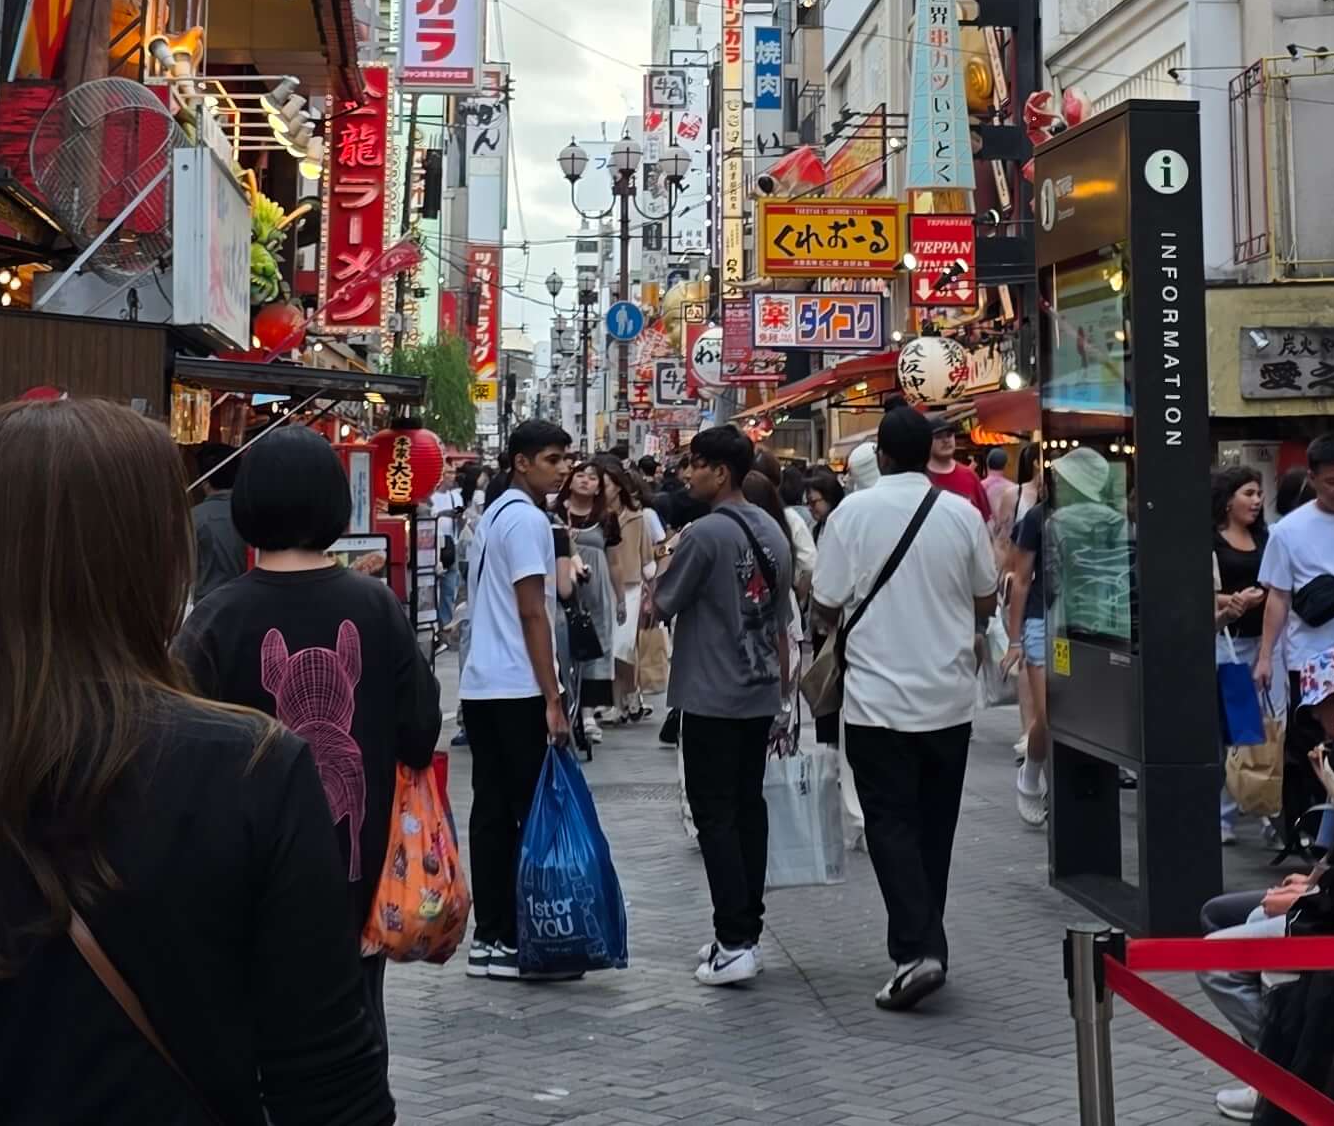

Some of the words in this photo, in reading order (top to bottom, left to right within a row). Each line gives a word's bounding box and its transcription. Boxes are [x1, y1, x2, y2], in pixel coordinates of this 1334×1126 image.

[756, 39, 781, 98] 焼肉
[773, 217, 890, 258] くれおーる
[913, 241, 973, 254] TEPPAN
[799, 299, 876, 341] ダイコク
[1160, 232, 1183, 447] INFORMATION
[527, 894, 552, 918] 1st
[531, 915, 575, 938] YOU
